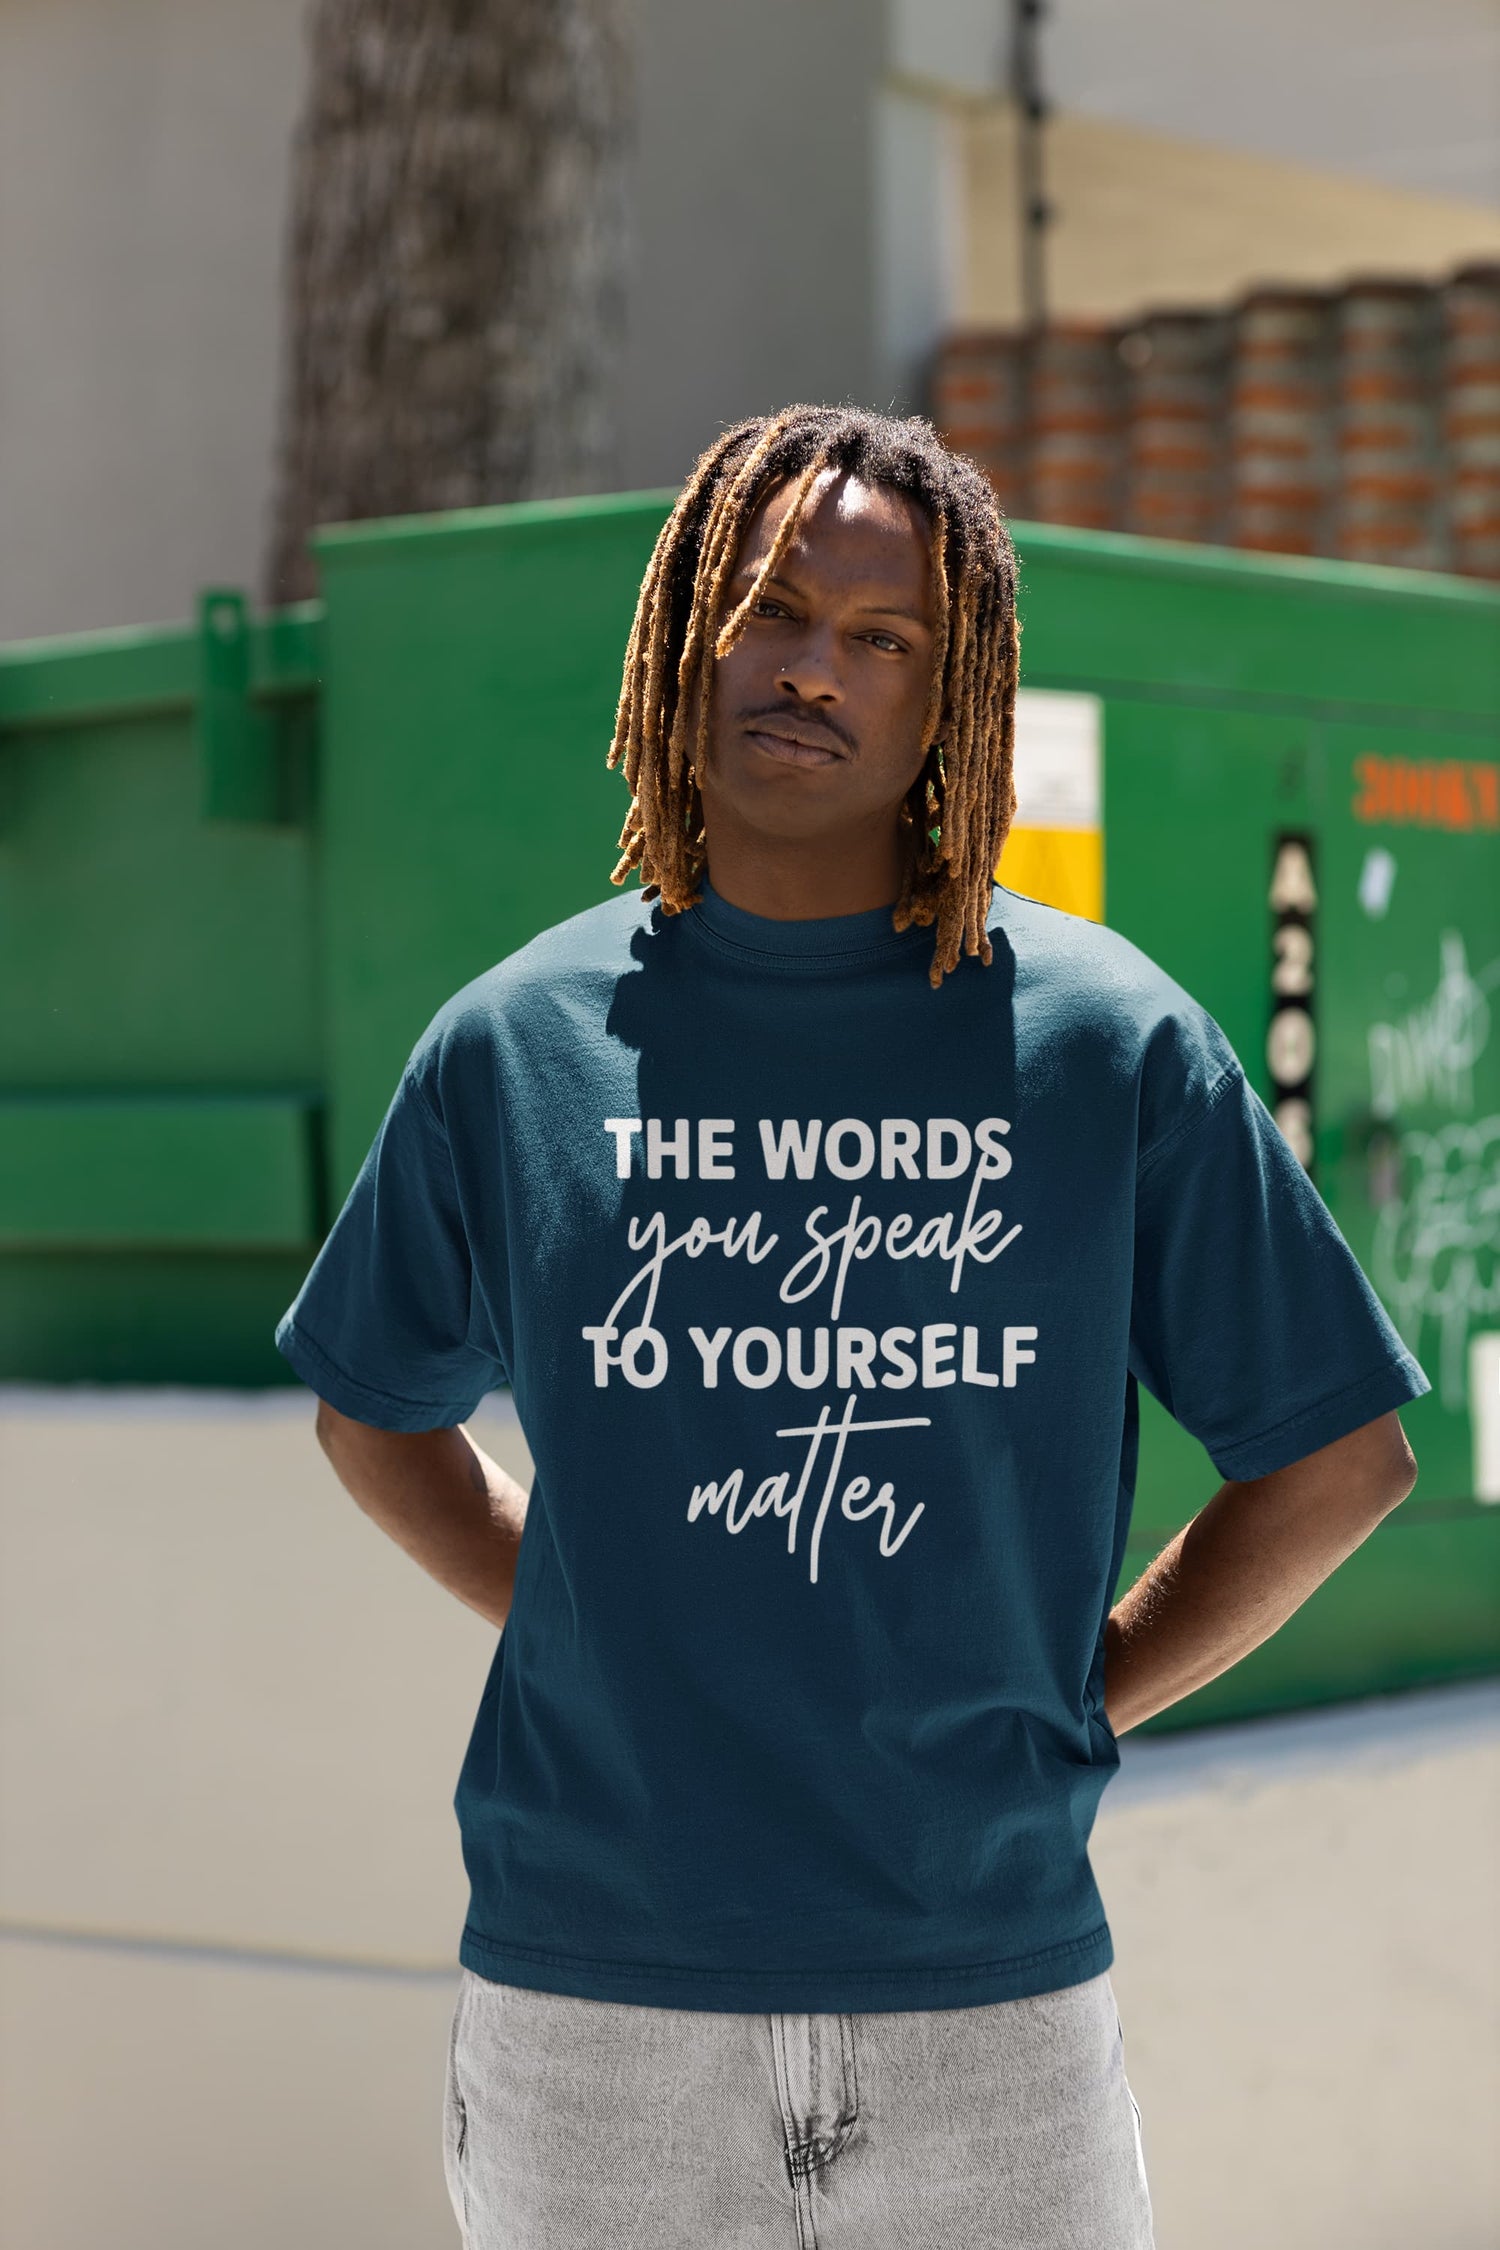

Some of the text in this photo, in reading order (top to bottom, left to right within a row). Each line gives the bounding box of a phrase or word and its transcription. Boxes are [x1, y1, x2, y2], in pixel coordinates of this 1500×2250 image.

[603, 1117, 1014, 1181] THE WORDS
[603, 1153, 1024, 1365] you speak
[582, 1322, 1039, 1390] TO YOURSELF
[687, 1393, 932, 1584] matter
